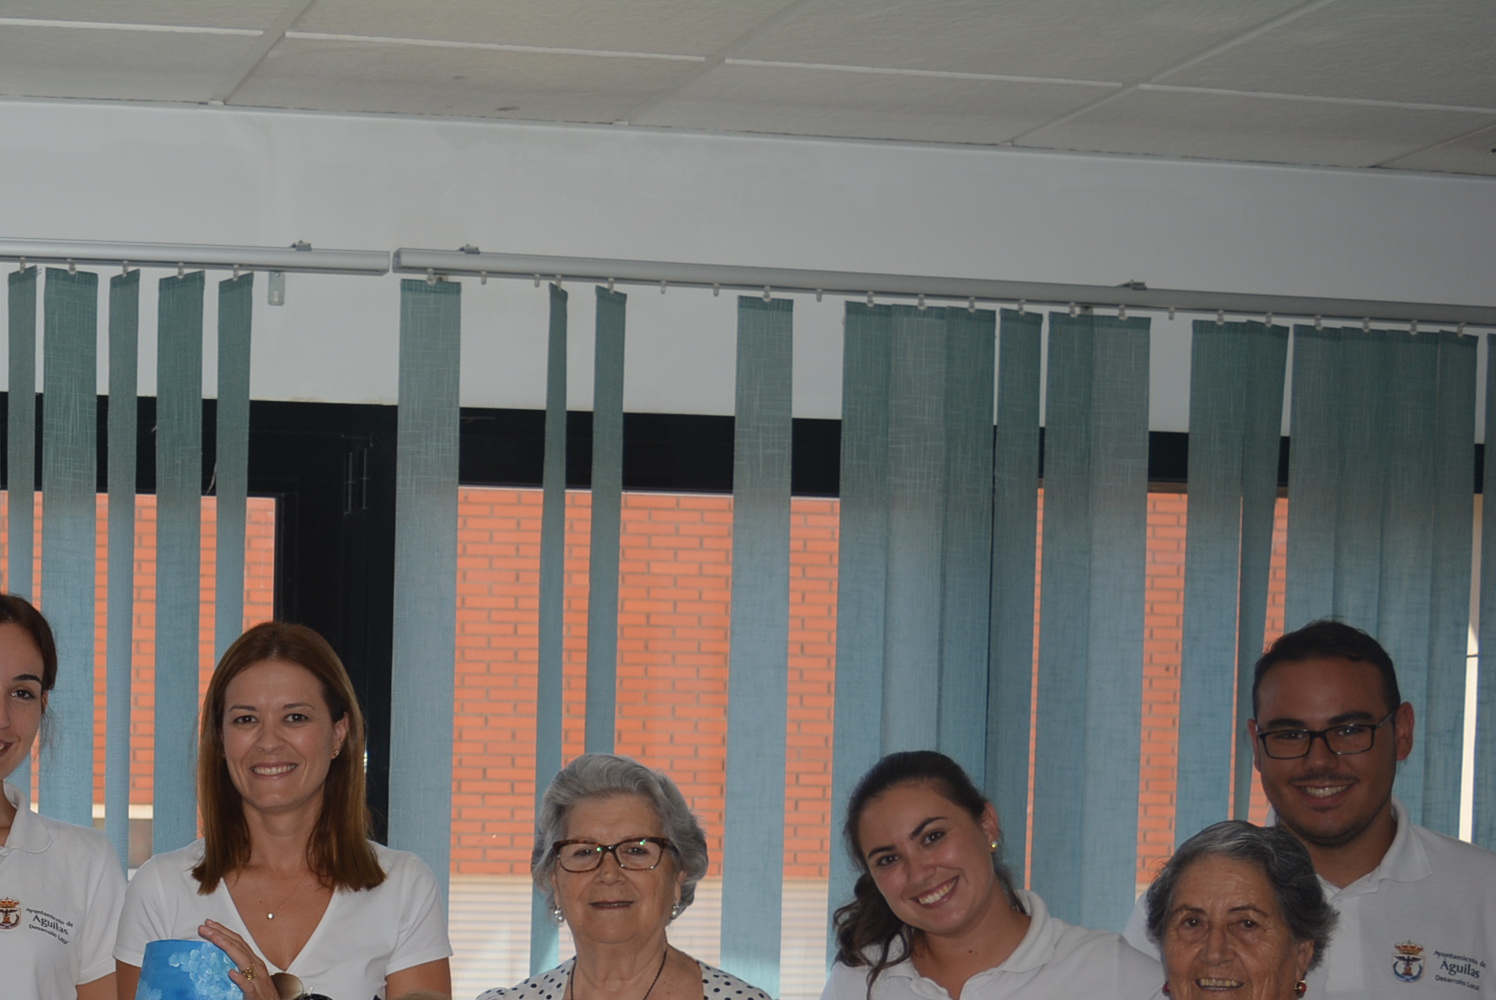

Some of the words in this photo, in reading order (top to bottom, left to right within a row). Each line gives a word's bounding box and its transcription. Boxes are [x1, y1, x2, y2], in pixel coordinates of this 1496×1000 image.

[26, 907, 64, 925] Ayuntamiento
[33, 914, 69, 935] Águilas
[29, 924, 57, 937] Desarrollo
[1433, 950, 1478, 965] Ayuntamiento
[1440, 958, 1480, 978] Águilas
[1435, 974, 1466, 986] Desarrollo
[1467, 981, 1480, 990] Local
